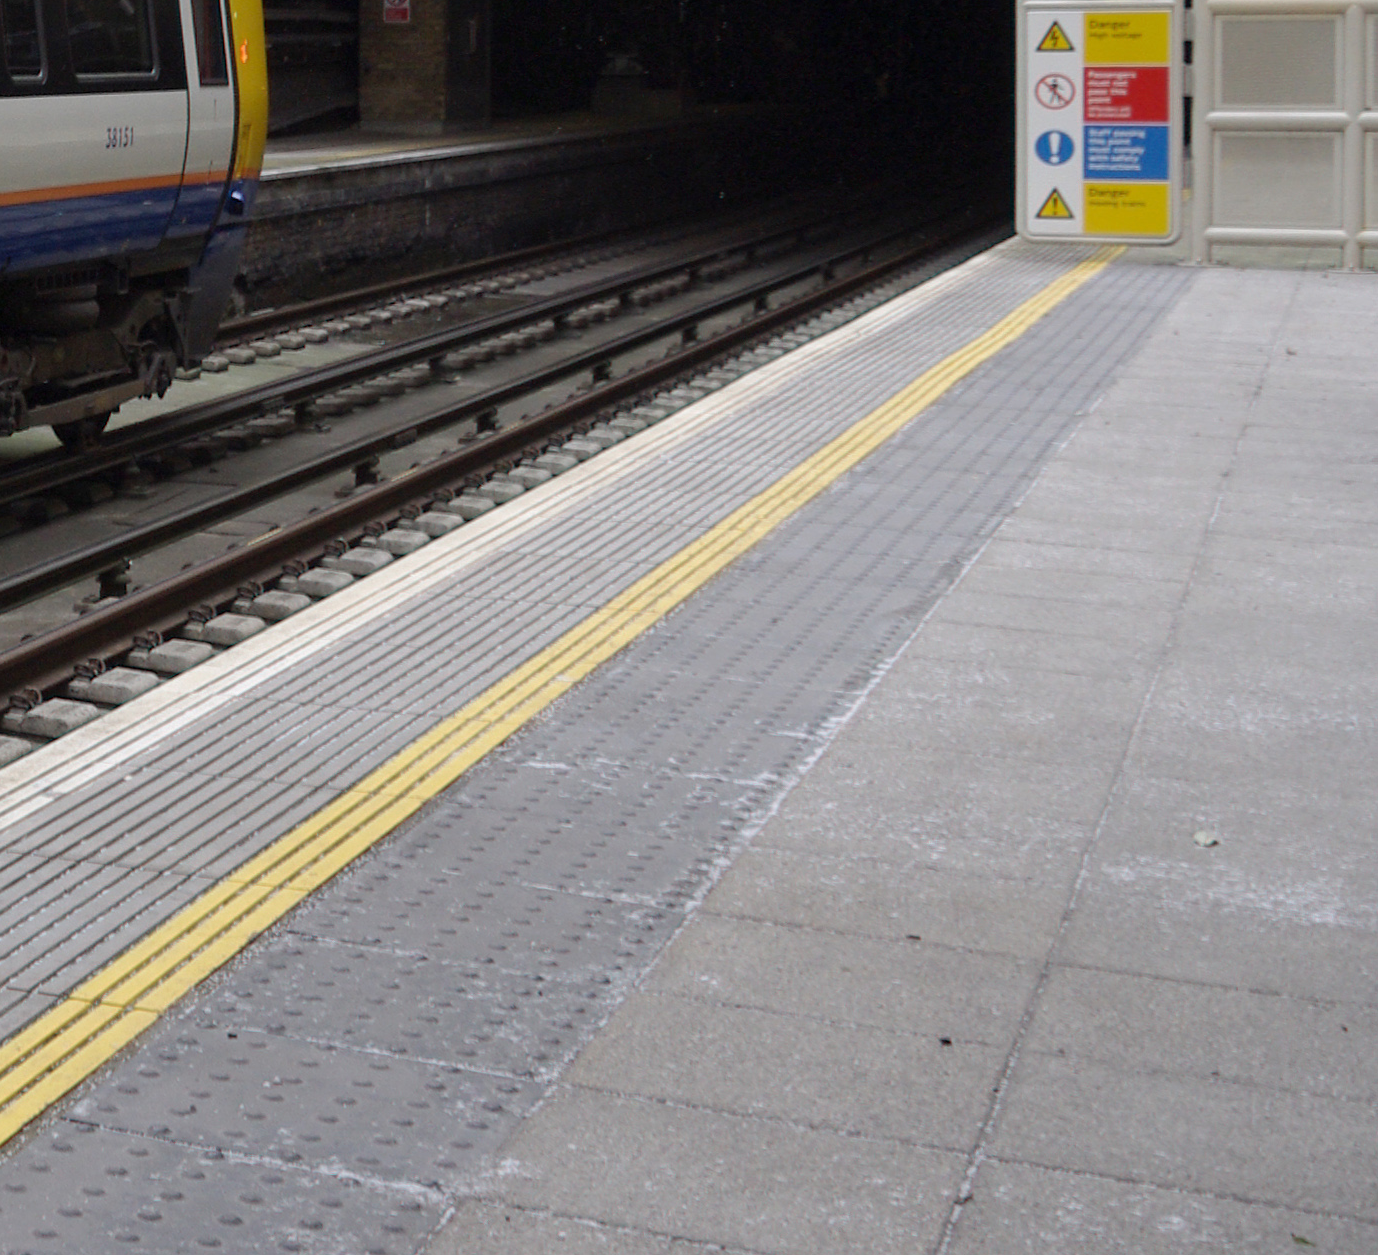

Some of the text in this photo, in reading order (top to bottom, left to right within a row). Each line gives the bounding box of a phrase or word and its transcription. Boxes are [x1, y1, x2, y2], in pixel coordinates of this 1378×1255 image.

[1089, 20, 1131, 30] Danger
[105, 126, 134, 149] 38151
[1088, 188, 1130, 198] Danger
